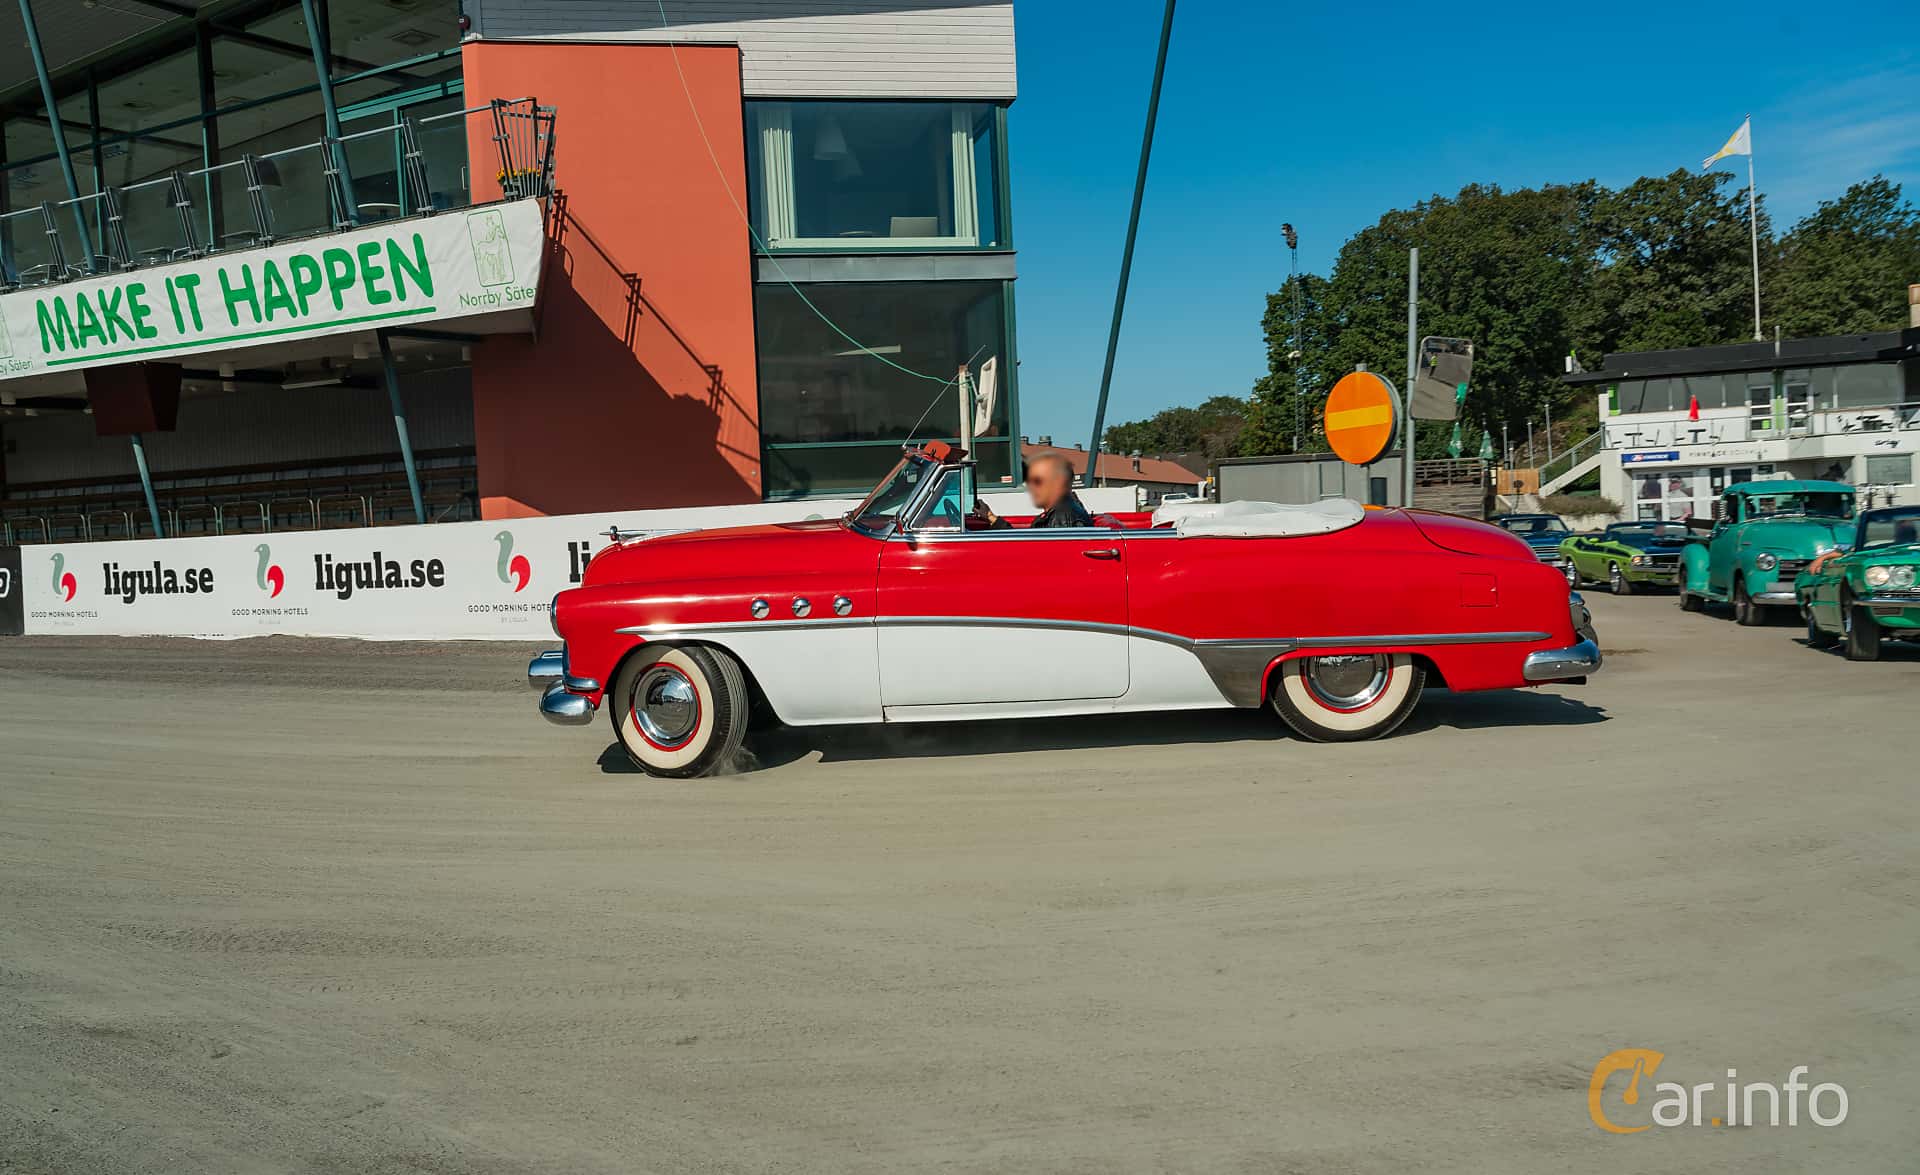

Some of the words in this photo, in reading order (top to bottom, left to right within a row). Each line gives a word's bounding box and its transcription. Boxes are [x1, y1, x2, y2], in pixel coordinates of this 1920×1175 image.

[36, 283, 157, 353] MAKE
[164, 273, 204, 334] IT
[218, 233, 435, 327] HAPPEN
[459, 289, 502, 308] Norrby
[103, 561, 214, 605] ligula.se
[314, 551, 445, 601] ligula.se
[76, 610, 98, 618] HOTELS
[231, 608, 250, 616] GOOD
[251, 608, 282, 616] MORNING
[283, 607, 309, 616] HOTELS
[467, 604, 490, 613] GOOD
[492, 603, 529, 612] MORNING
